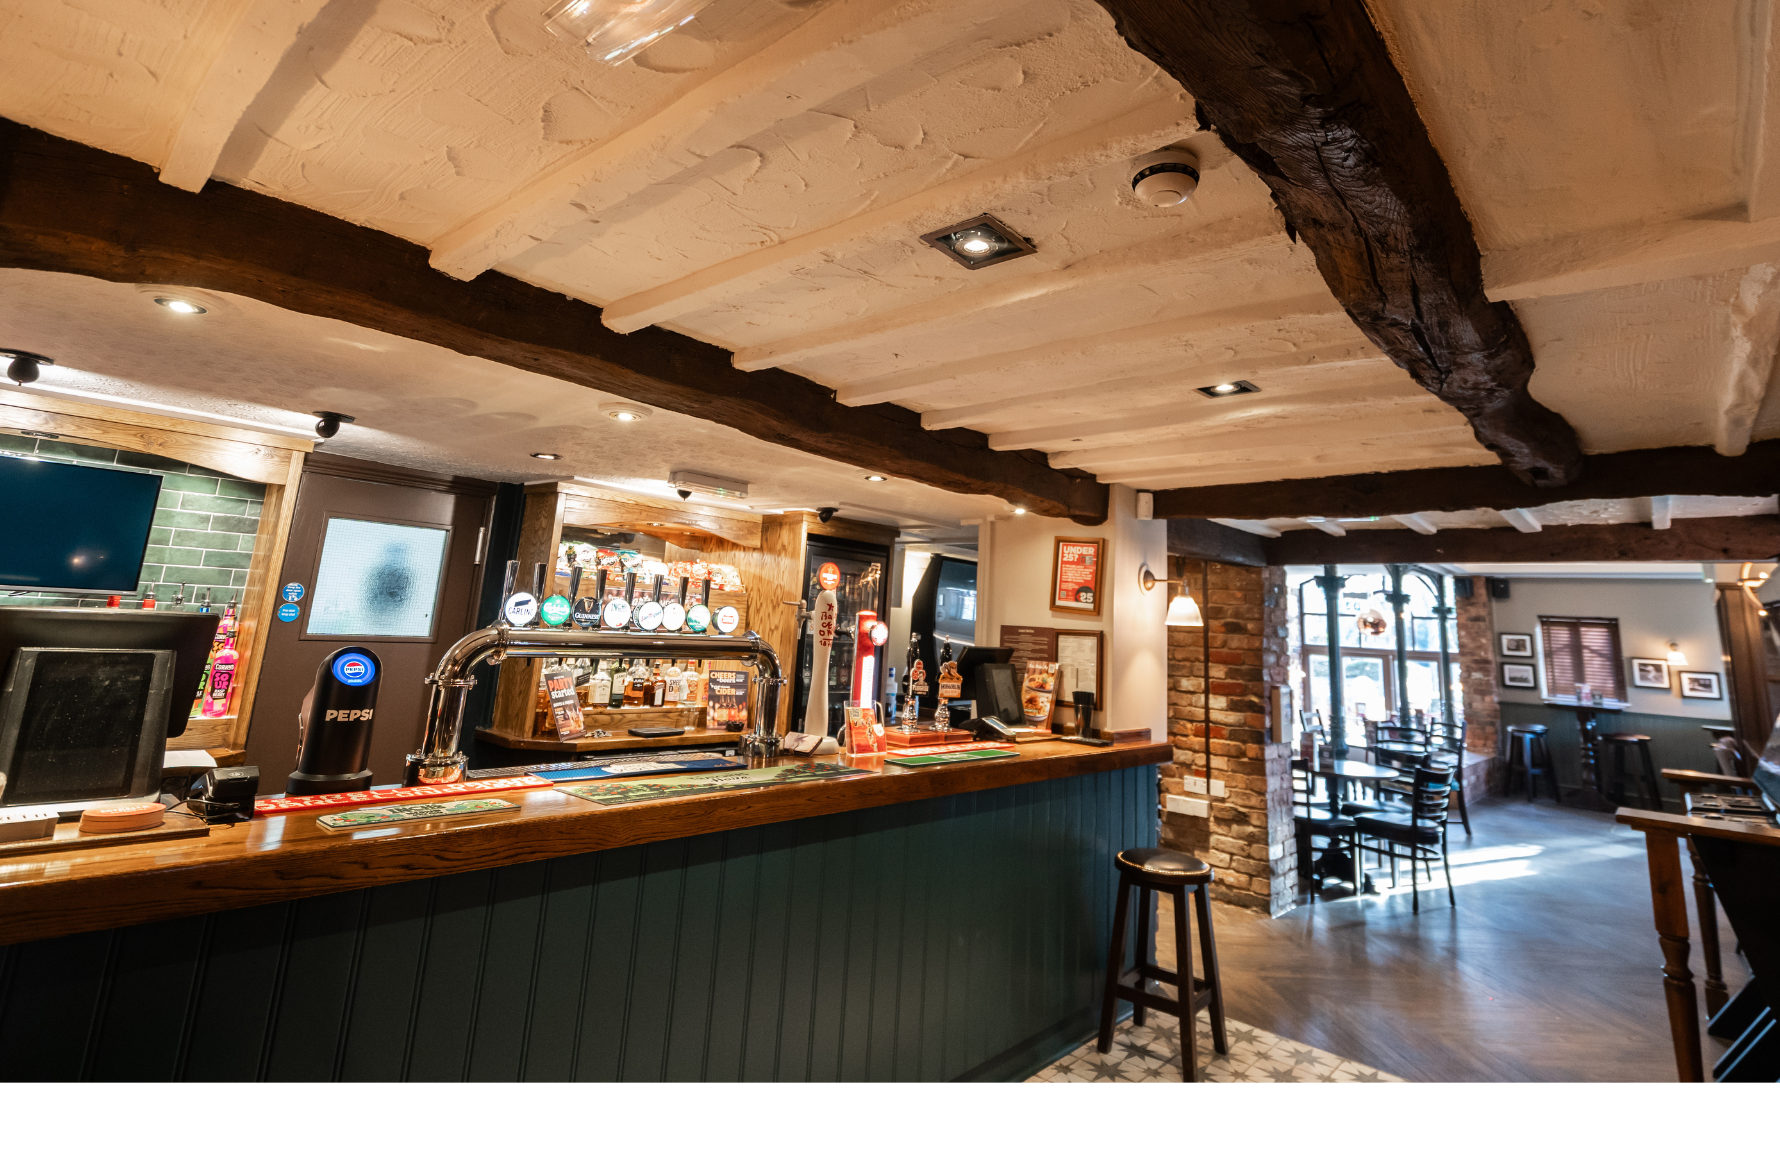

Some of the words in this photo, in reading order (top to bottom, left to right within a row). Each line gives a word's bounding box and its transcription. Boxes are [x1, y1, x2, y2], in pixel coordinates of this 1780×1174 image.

[1063, 545, 1095, 555] UNDER
[1062, 553, 1079, 562] 25?
[1080, 591, 1094, 603] 25
[575, 612, 600, 620] GUINNESS
[710, 671, 737, 679] CHEERS
[547, 676, 574, 692] PARTY
[551, 685, 576, 700] started
[325, 708, 374, 722] PEPSI
